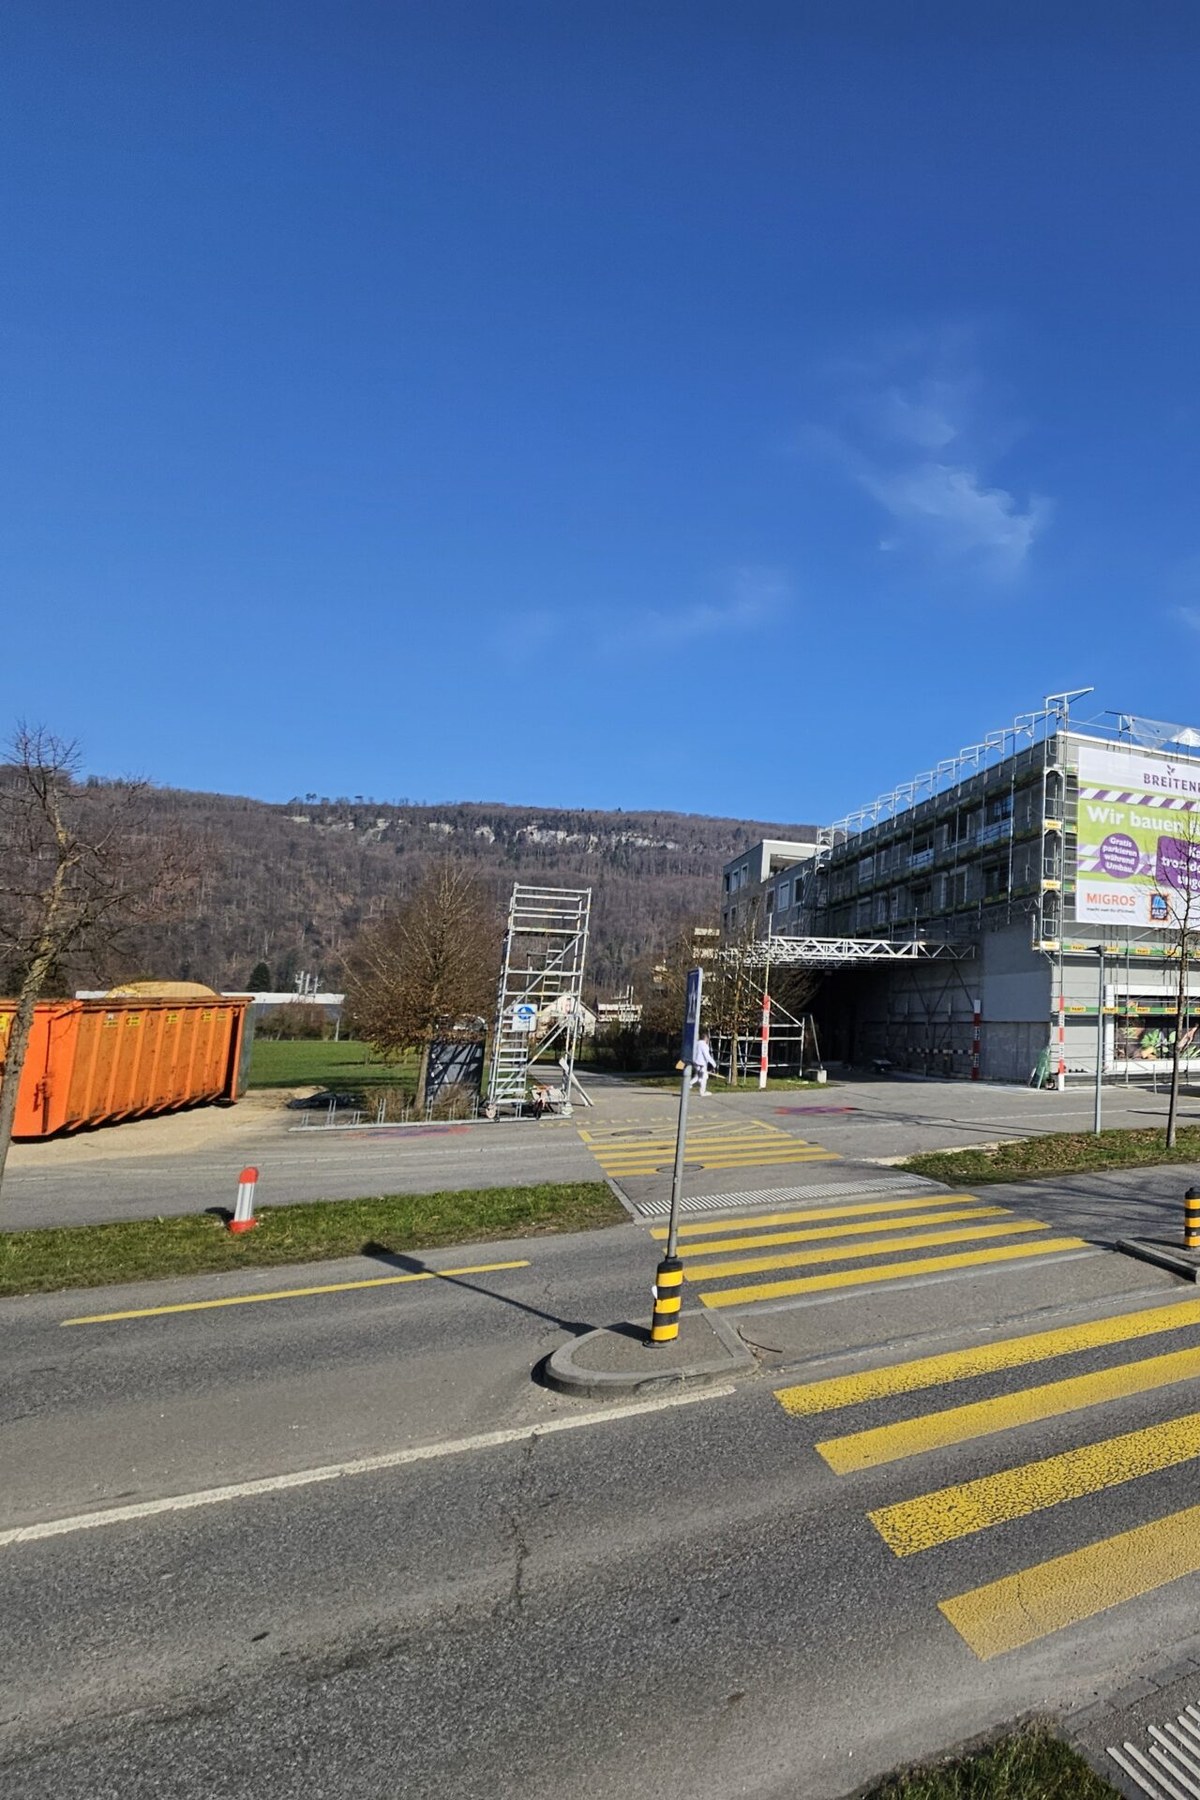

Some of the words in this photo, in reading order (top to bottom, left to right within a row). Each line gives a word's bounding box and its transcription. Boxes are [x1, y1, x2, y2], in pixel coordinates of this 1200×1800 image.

[1086, 805, 1125, 825] Wir
[1130, 810, 1184, 833] bauen
[1109, 837, 1132, 848] Gratis
[1103, 845, 1138, 857] parkieren
[1104, 853, 1135, 865] während
[1105, 862, 1135, 873] Umbau.
[1086, 893, 1136, 906] MIGROS
